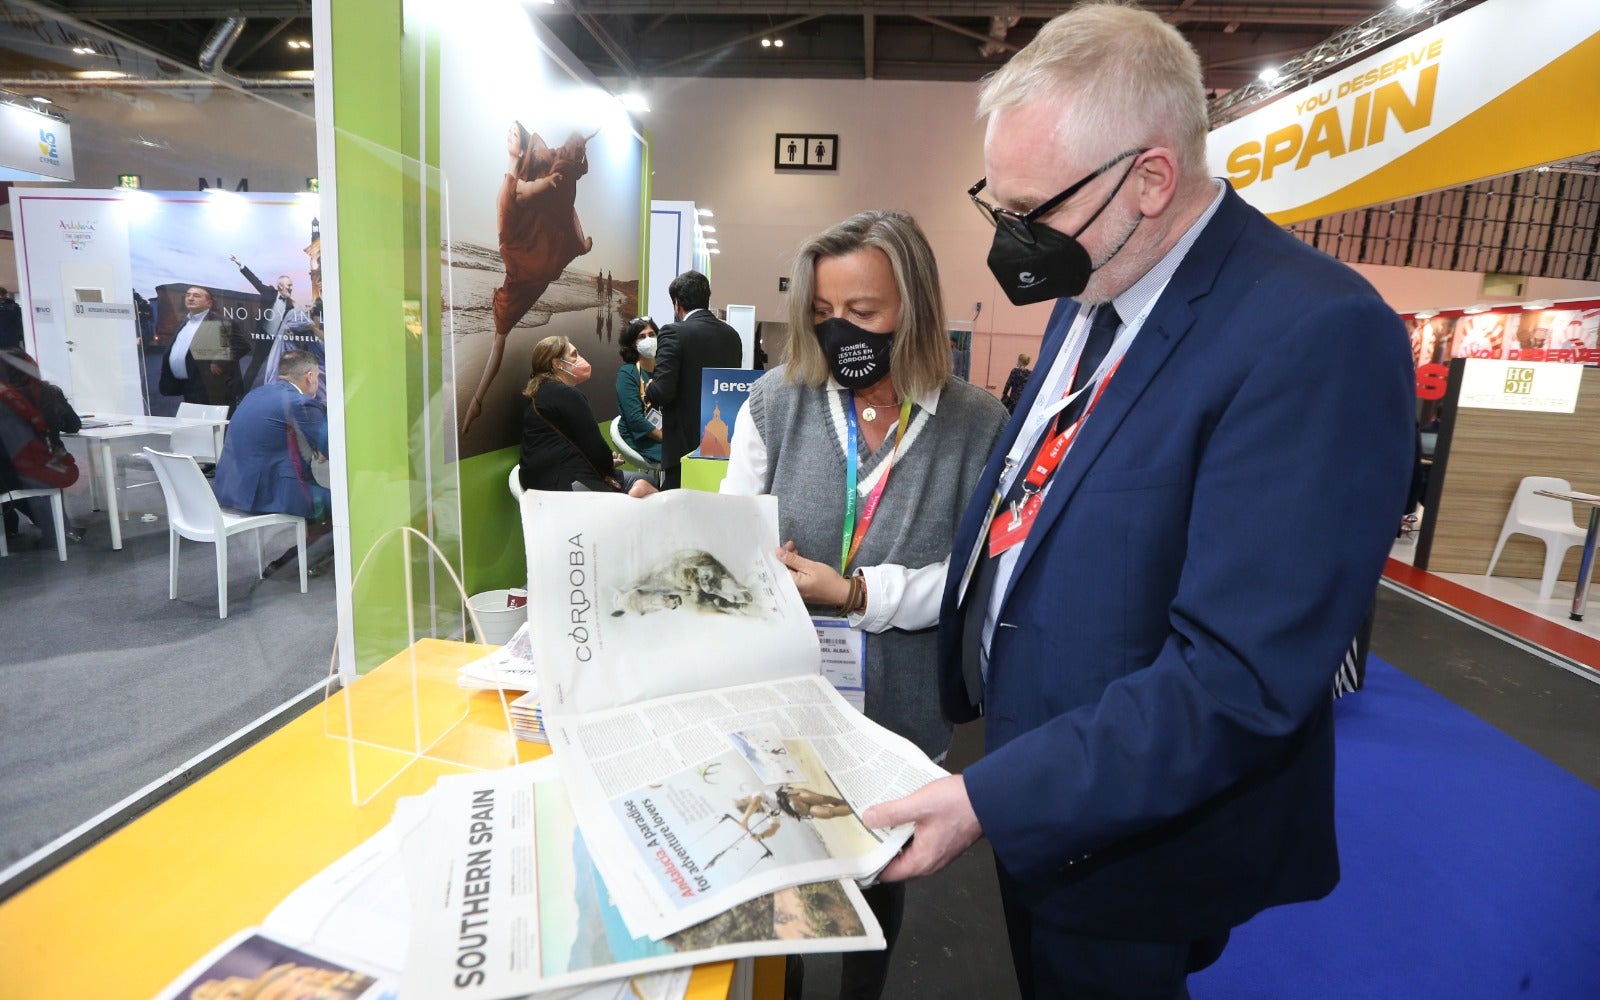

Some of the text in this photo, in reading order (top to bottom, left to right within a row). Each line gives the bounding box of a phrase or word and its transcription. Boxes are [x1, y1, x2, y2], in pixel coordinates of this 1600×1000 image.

[1296, 38, 1443, 116] YOU DESERVE
[1225, 62, 1439, 190] SPAIN
[223, 306, 248, 320] NO
[254, 308, 286, 321] JOY
[294, 310, 311, 323] IN
[251, 333, 275, 341] TREAT
[1471, 349, 1502, 360] YOU
[711, 378, 752, 395] Jerez
[624, 799, 657, 840] paradise
[642, 798, 665, 828] lovers
[647, 839, 660, 848] A
[660, 826, 700, 875] adventure
[454, 788, 495, 989] SOUTHERN SPAIN
[693, 875, 711, 892] for
